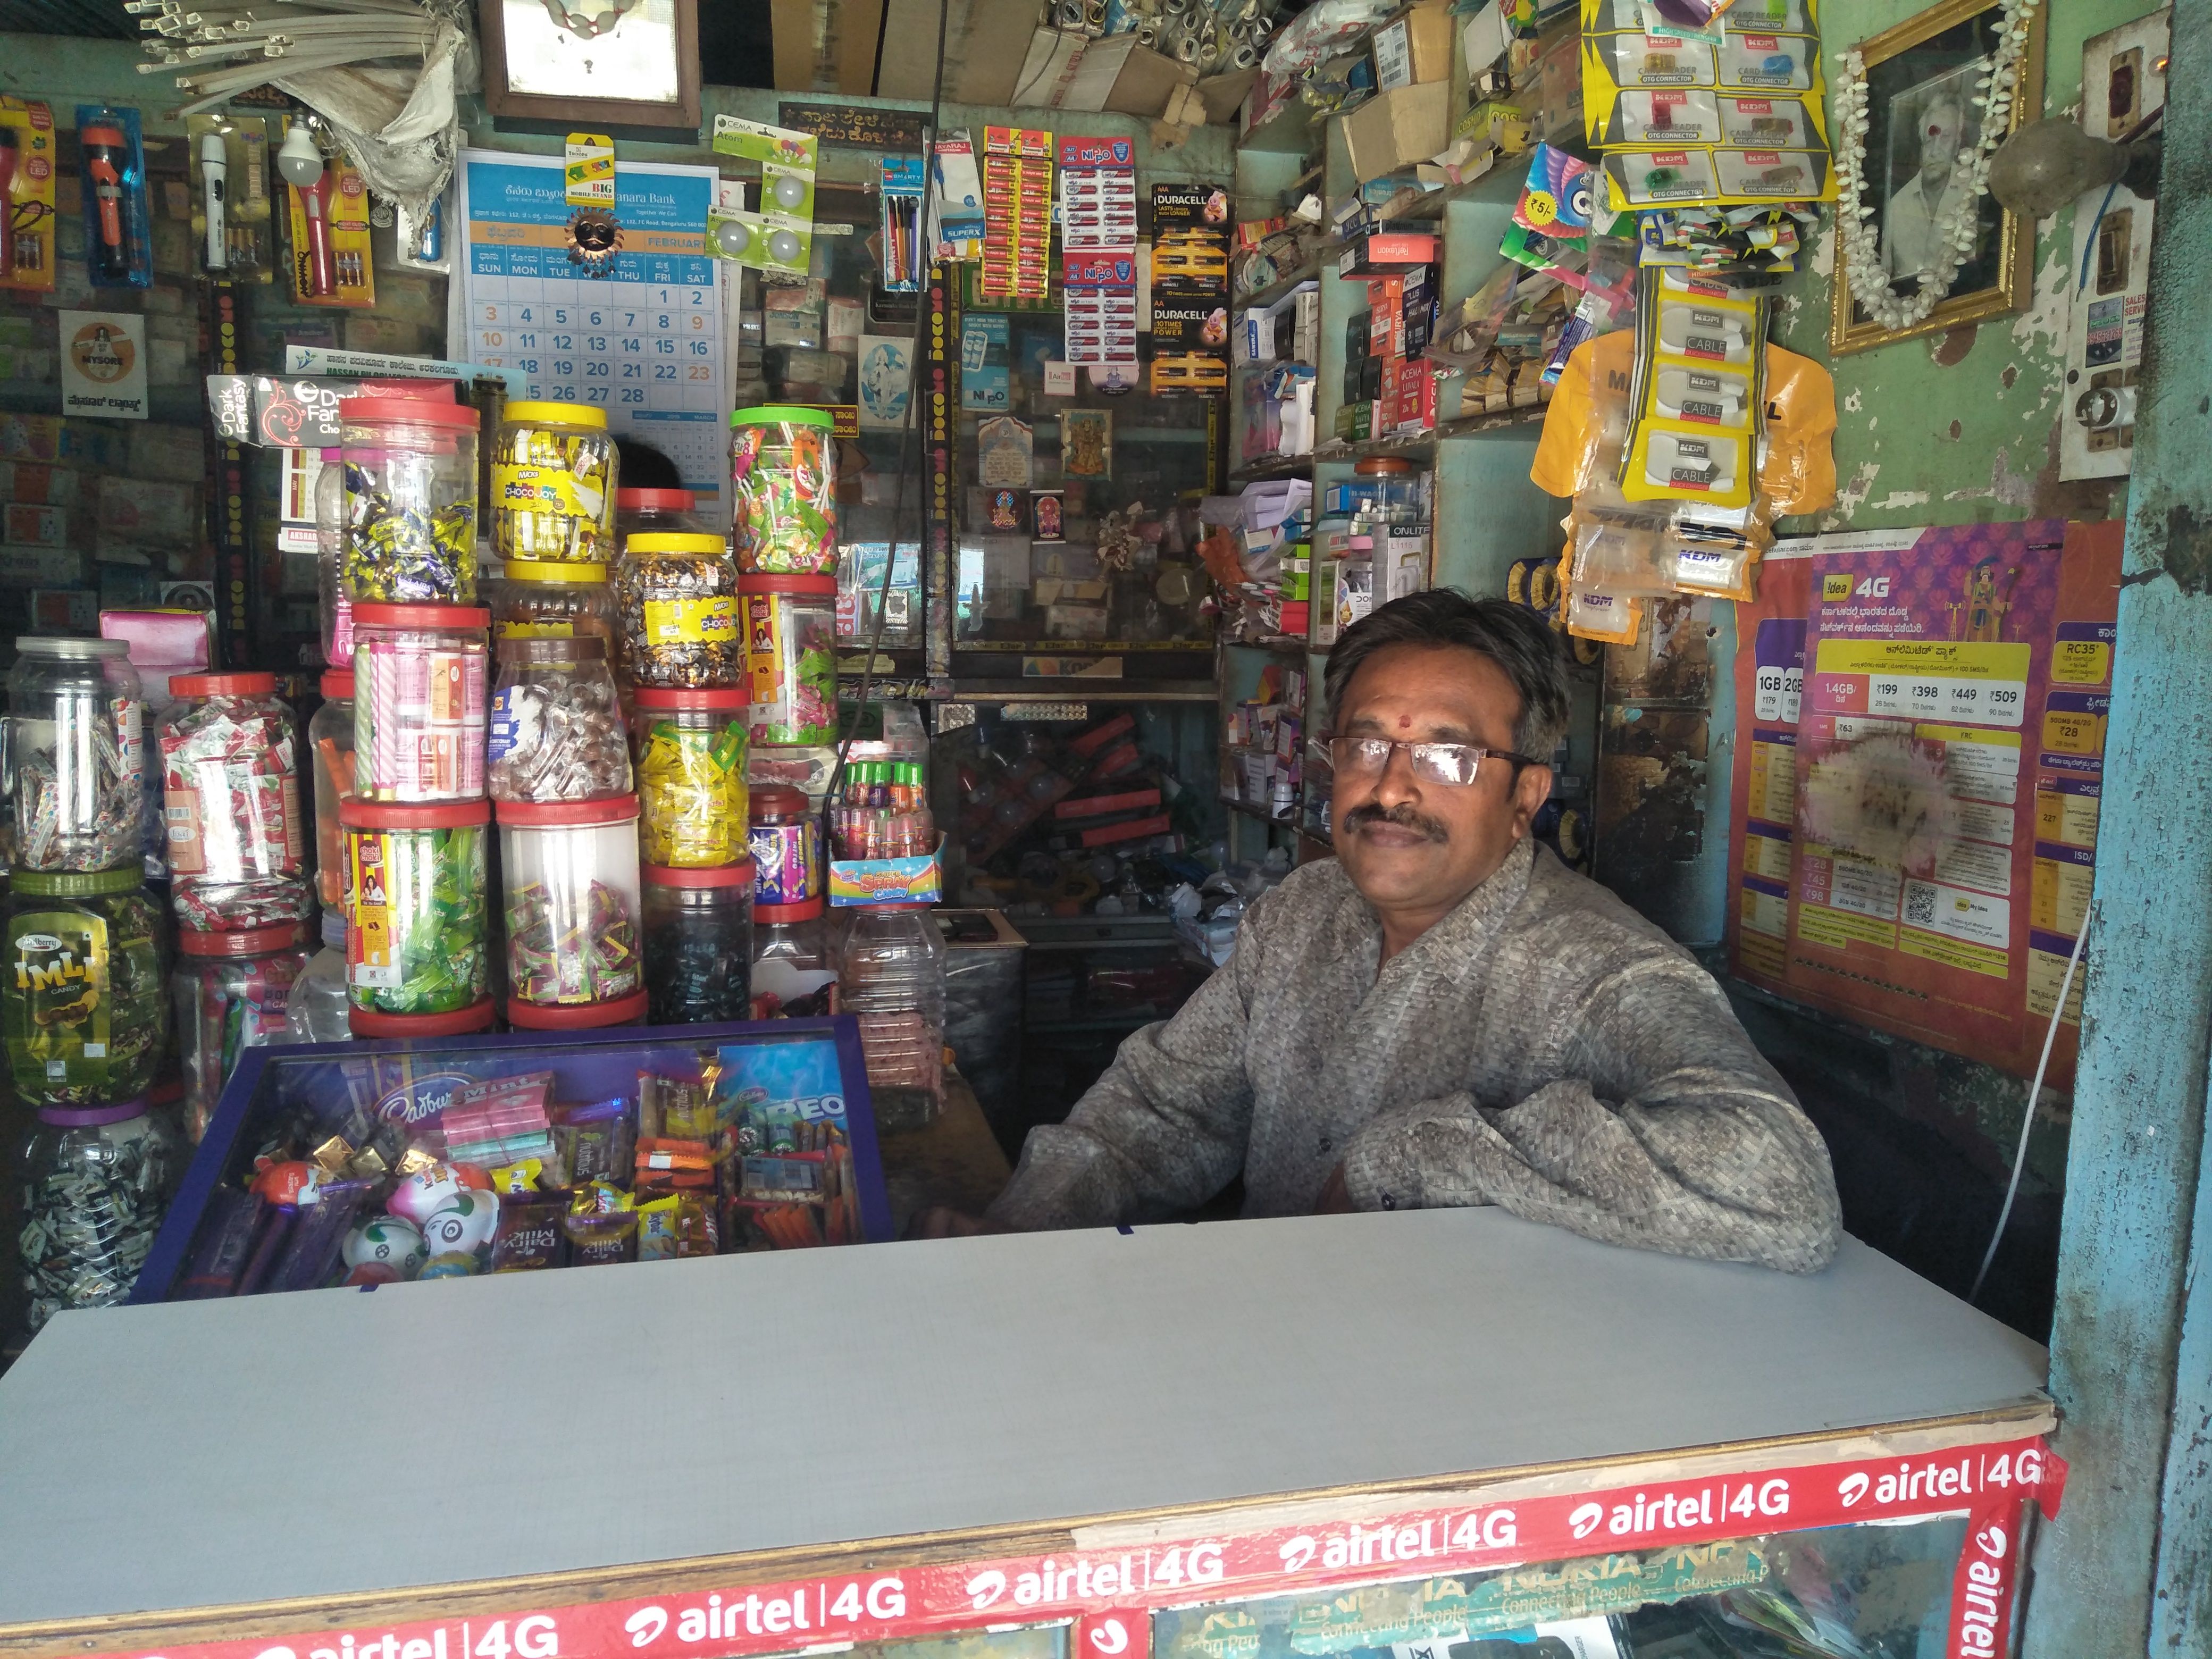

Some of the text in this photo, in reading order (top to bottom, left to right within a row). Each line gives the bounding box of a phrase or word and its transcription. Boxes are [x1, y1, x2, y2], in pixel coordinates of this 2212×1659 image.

[727, 120, 752, 132] CEMA
[716, 131, 743, 144] Atom
[30, 167, 48, 176] LED
[773, 165, 792, 175] CEMA
[342, 185, 360, 194] LED
[592, 183, 613, 194] BIG
[616, 192, 676, 205] anara Bank
[1157, 195, 1207, 205] DURACELL
[1377, 246, 1409, 256] Reflexion
[478, 263, 501, 273] SUN
[512, 265, 538, 275] MON
[549, 267, 571, 277] TUE
[617, 271, 640, 281] THU
[655, 272, 671, 282] FRI
[686, 274, 706, 284] SAT
[659, 289, 667, 304] 1
[691, 290, 703, 305] 2
[485, 306, 497, 321] 3
[520, 308, 532, 322] 4
[555, 309, 567, 324] 5
[590, 311, 602, 325] 6
[624, 313, 635, 327] 7
[658, 314, 669, 329] 8
[691, 315, 703, 330] 9
[482, 332, 502, 347] 10
[520, 333, 535, 348] 11
[552, 335, 573, 350] 12
[587, 337, 607, 351] 13
[621, 338, 641, 353] 14
[655, 339, 675, 354] 15
[1687, 337, 1726, 353] CABLE
[689, 341, 708, 356] 16
[518, 359, 539, 374] 18
[553, 361, 573, 375] 19
[586, 362, 609, 376] 20
[623, 363, 642, 378] 21
[655, 365, 677, 379] 22
[688, 365, 710, 381] 23
[552, 386, 576, 401] 26
[587, 387, 610, 402] 27
[621, 388, 644, 404] 28
[219, 388, 236, 423] Dark
[232, 378, 247, 433] Fantasy
[1682, 401, 1722, 417] CABLE
[517, 470, 539, 479] MICKS
[1672, 468, 1711, 483] CABLE
[505, 487, 557, 499] CHOCO JOY
[1855, 577, 1890, 598] 4G
[1759, 676, 1781, 691] 1GB
[1876, 684, 1898, 695] ₹199
[1912, 686, 1939, 699] ₹398
[1951, 688, 1978, 701] ₹449
[1989, 690, 2017, 703] ₹509
[2059, 726, 2079, 737] ₹28
[2043, 814, 2056, 823] 227
[859, 872, 913, 893] SPRAY
[873, 887, 909, 901] CANDY
[14, 951, 97, 992] IMLI
[51, 984, 81, 995] CANDY
[464, 1077, 531, 1099] Mint
[503, 1237, 556, 1249] Dairy
[1875, 1448, 2041, 1504] airtel 4G
[1609, 1478, 1790, 1535] airtel 4G
[1321, 1509, 1517, 1567] airtel 4G
[1014, 1543, 1224, 1604] airtel 4G
[677, 1577, 907, 1644] airtel 4G
[475, 1614, 559, 1658] 4G
